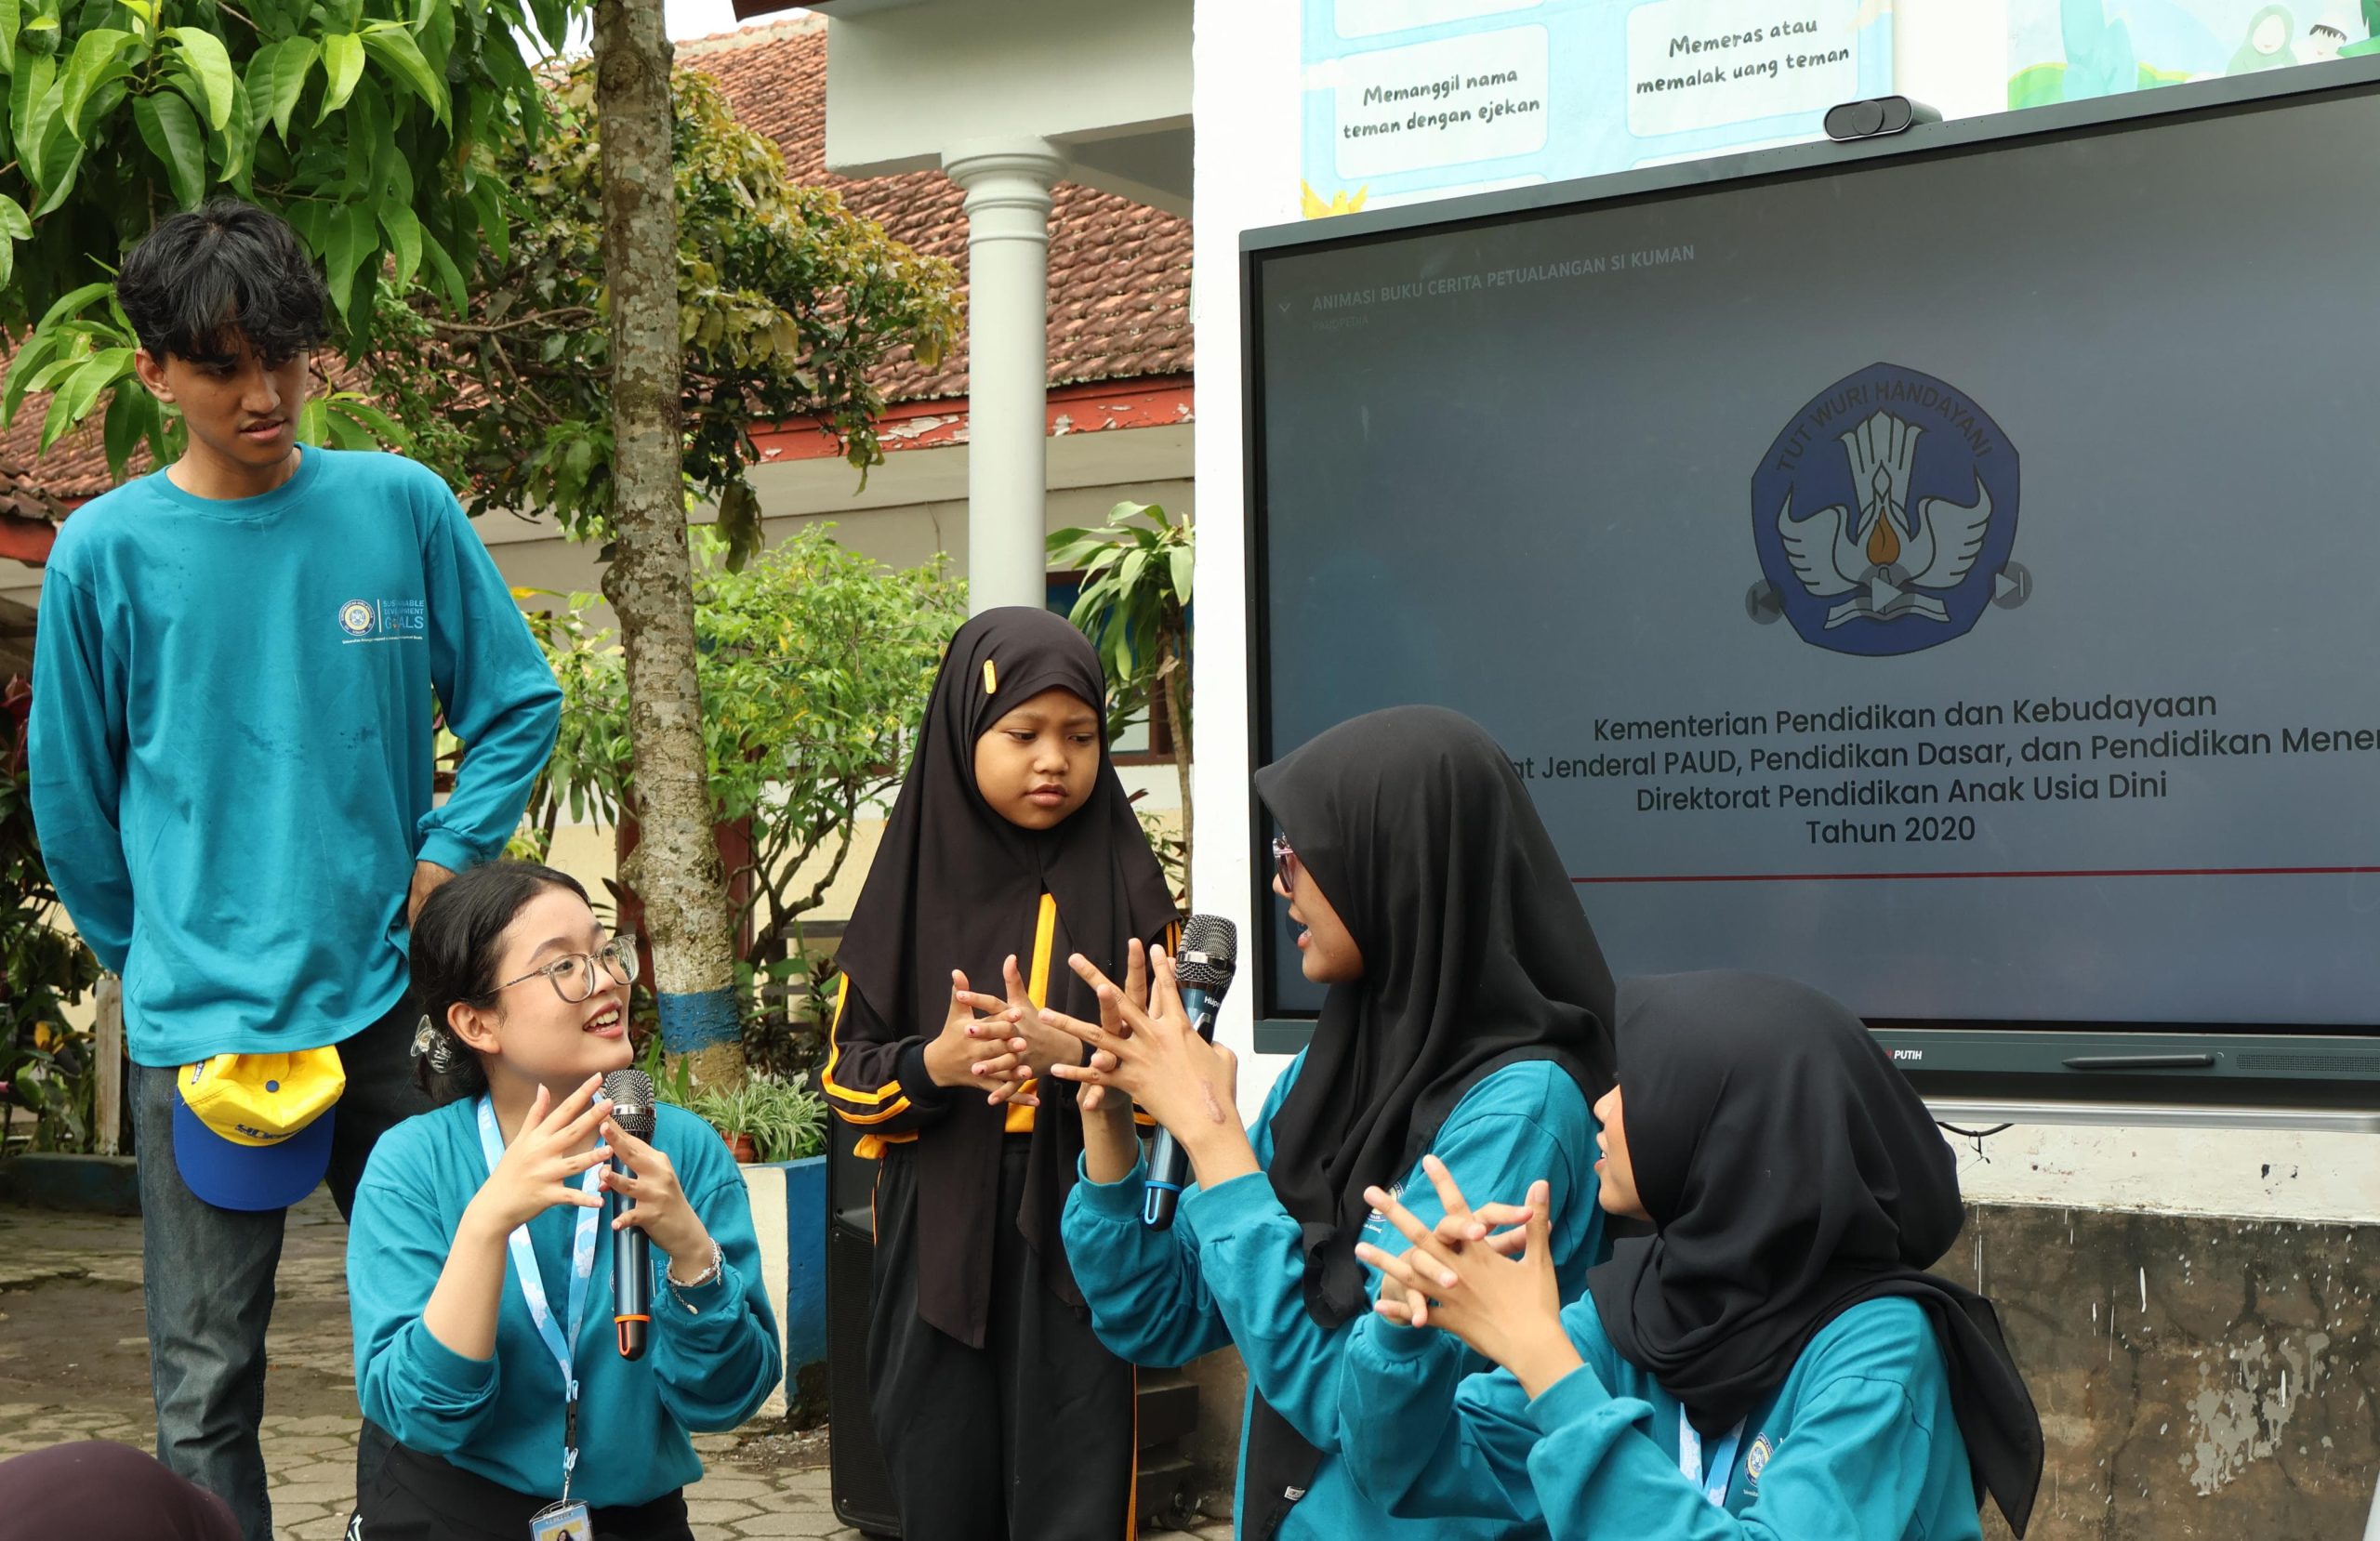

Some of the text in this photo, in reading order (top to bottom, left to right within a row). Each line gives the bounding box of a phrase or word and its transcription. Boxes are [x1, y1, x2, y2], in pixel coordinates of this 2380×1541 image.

[1670, 20, 1817, 58] Memeras atau
[1364, 71, 1517, 106] Memanggil nama
[1637, 49, 1848, 94] memalak uang teman
[1343, 99, 1540, 138] teman dengan ejekan
[1313, 245, 1694, 310] ANIMASI BUKU CERITA PETUALANGAN SI KUMAN
[1777, 380, 1992, 472] TUT WURI HANDAYANI
[1595, 694, 2215, 741] Kementerian Pendidikan dan Kebudayaan
[1542, 752, 1655, 778] Jenderal
[1665, 750, 1741, 776] PAUD,
[1752, 744, 1908, 771] Pendidikan
[1919, 743, 2012, 767] Dasar,
[2021, 736, 2081, 761] dan
[2092, 730, 2270, 759] Pendidikan
[2282, 728, 2380, 753] Mene
[1638, 770, 2166, 810] Direktorat Pendidikan Anak Usia Dini
[1806, 816, 1975, 843] Tahun 2020
[1894, 1049, 1923, 1060] PUTIH
